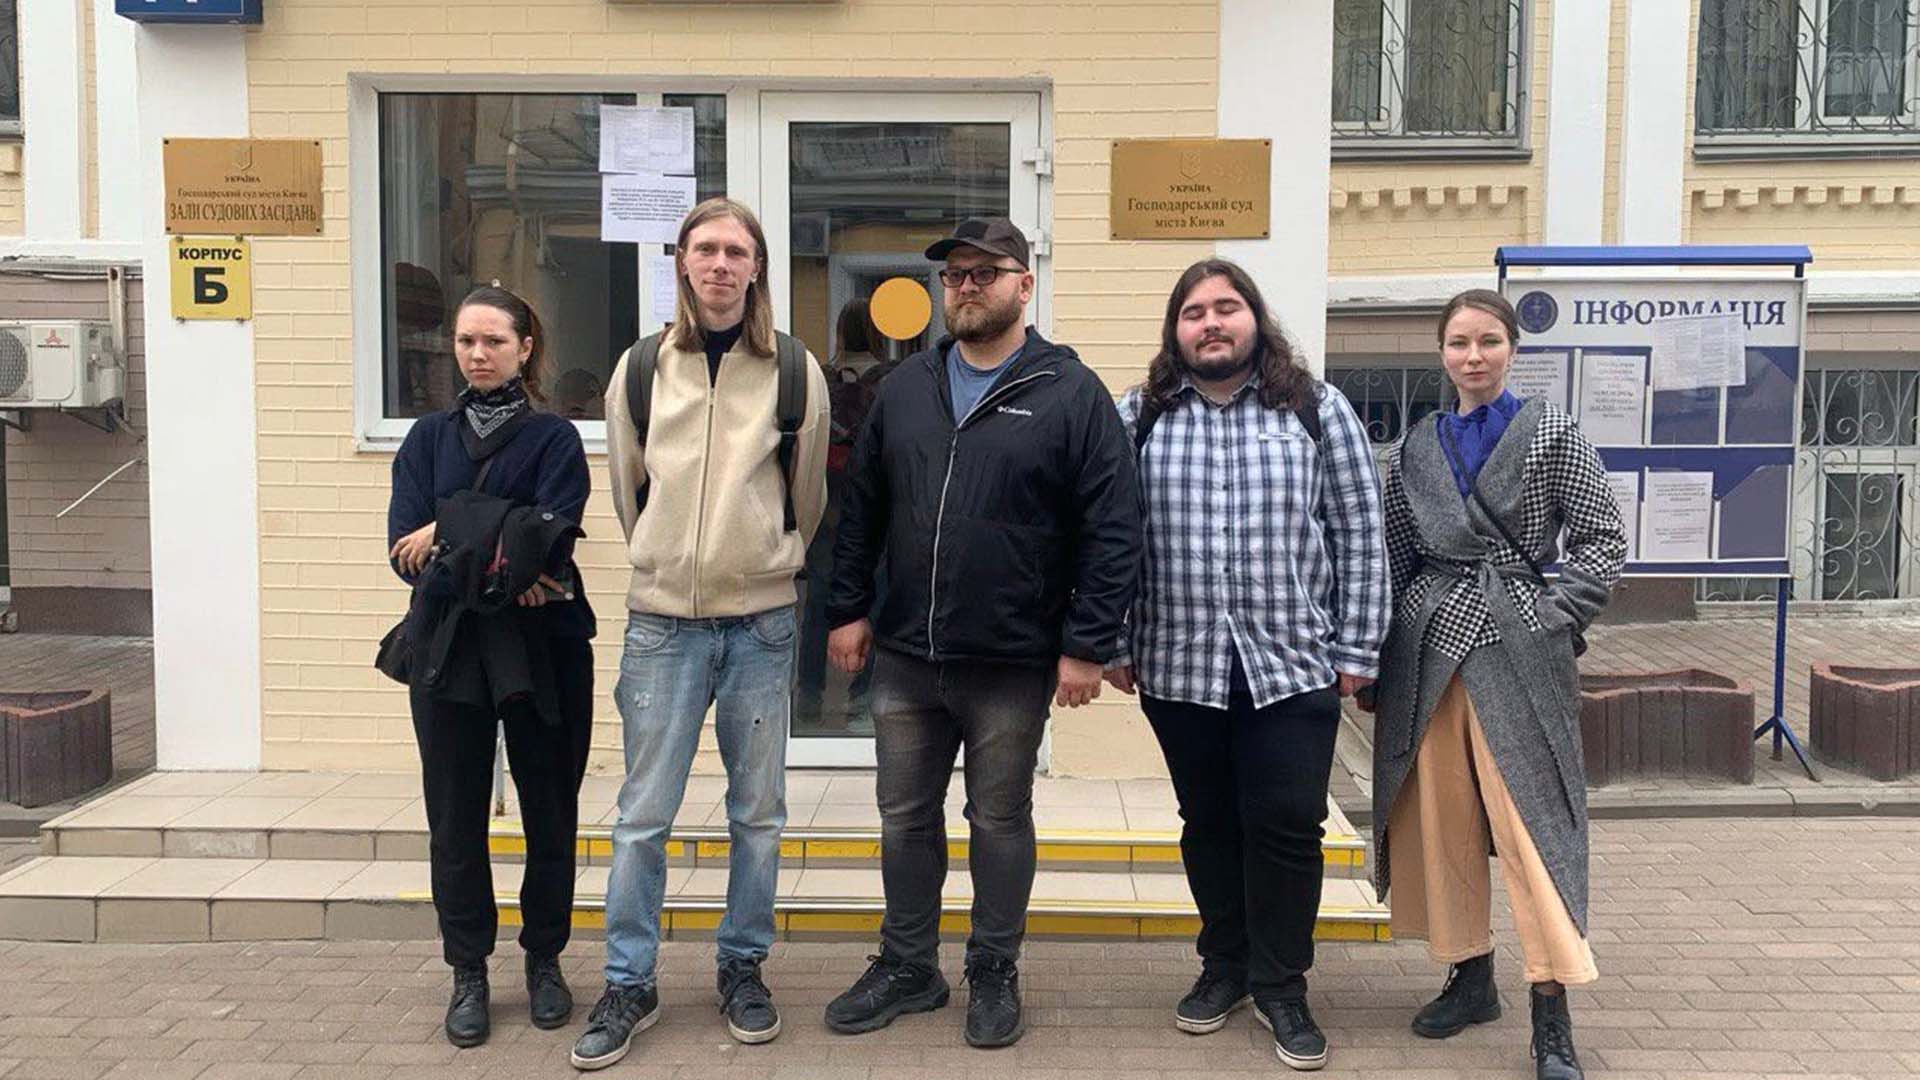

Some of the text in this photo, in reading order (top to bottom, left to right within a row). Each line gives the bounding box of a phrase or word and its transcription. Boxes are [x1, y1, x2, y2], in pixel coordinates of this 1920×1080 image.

[224, 175, 261, 183] УКРАЇНА
[177, 188, 241, 200] Господарський
[242, 190, 257, 200] суд
[1169, 183, 1211, 193] УКРАЇНА
[1128, 198, 1253, 214] Господарський суд
[170, 203, 317, 222] ЗАЛИ СУДОВИХ ЗАСІДАНЬ
[1155, 217, 1225, 228] міста Києва
[178, 248, 243, 261] КОРПУС
[193, 267, 229, 305] Б
